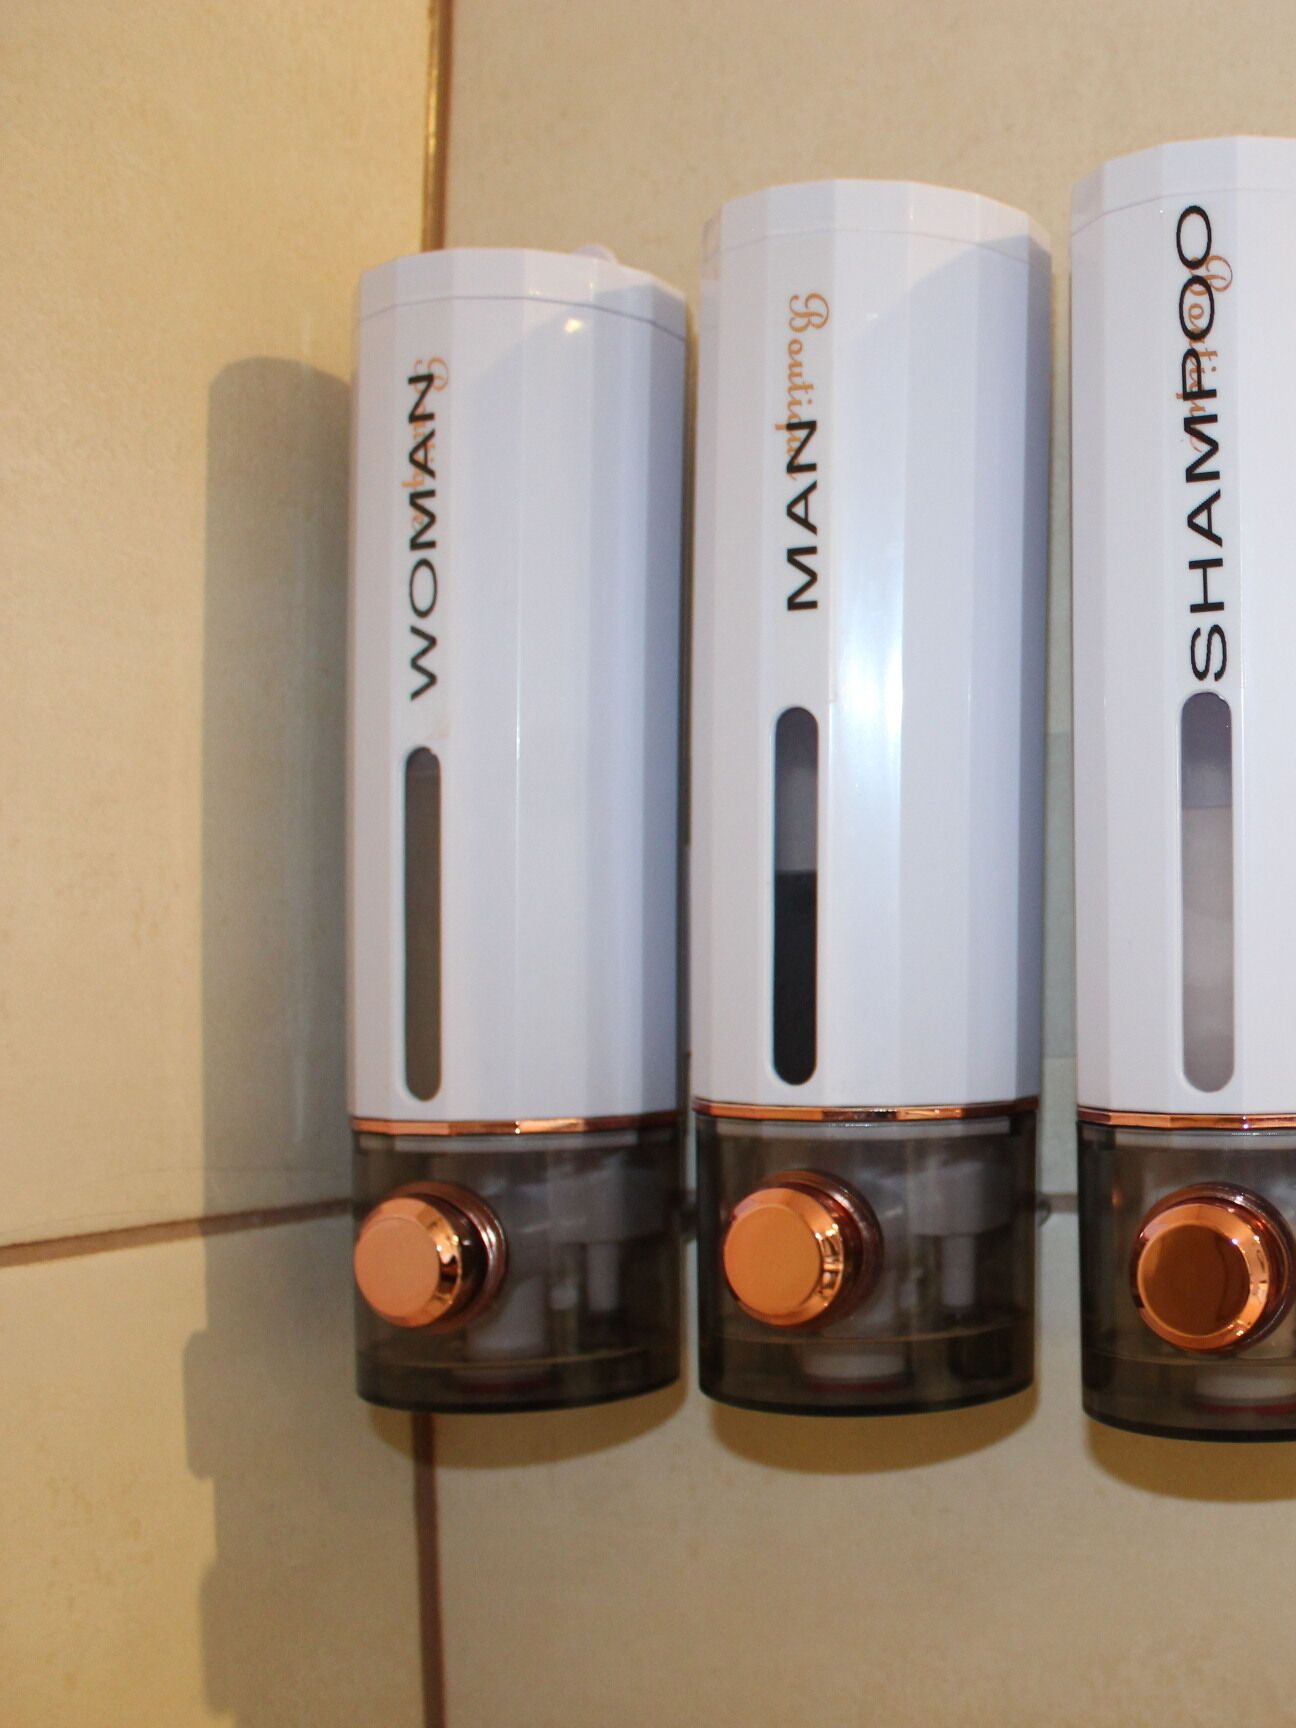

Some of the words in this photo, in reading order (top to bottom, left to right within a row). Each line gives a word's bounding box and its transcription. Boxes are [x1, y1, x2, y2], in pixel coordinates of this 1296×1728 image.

[401, 356, 449, 535] Boutiqe
[408, 372, 438, 700] WOMAN
[785, 420, 818, 611] MAN
[1175, 205, 1228, 682] SHAMPOO
